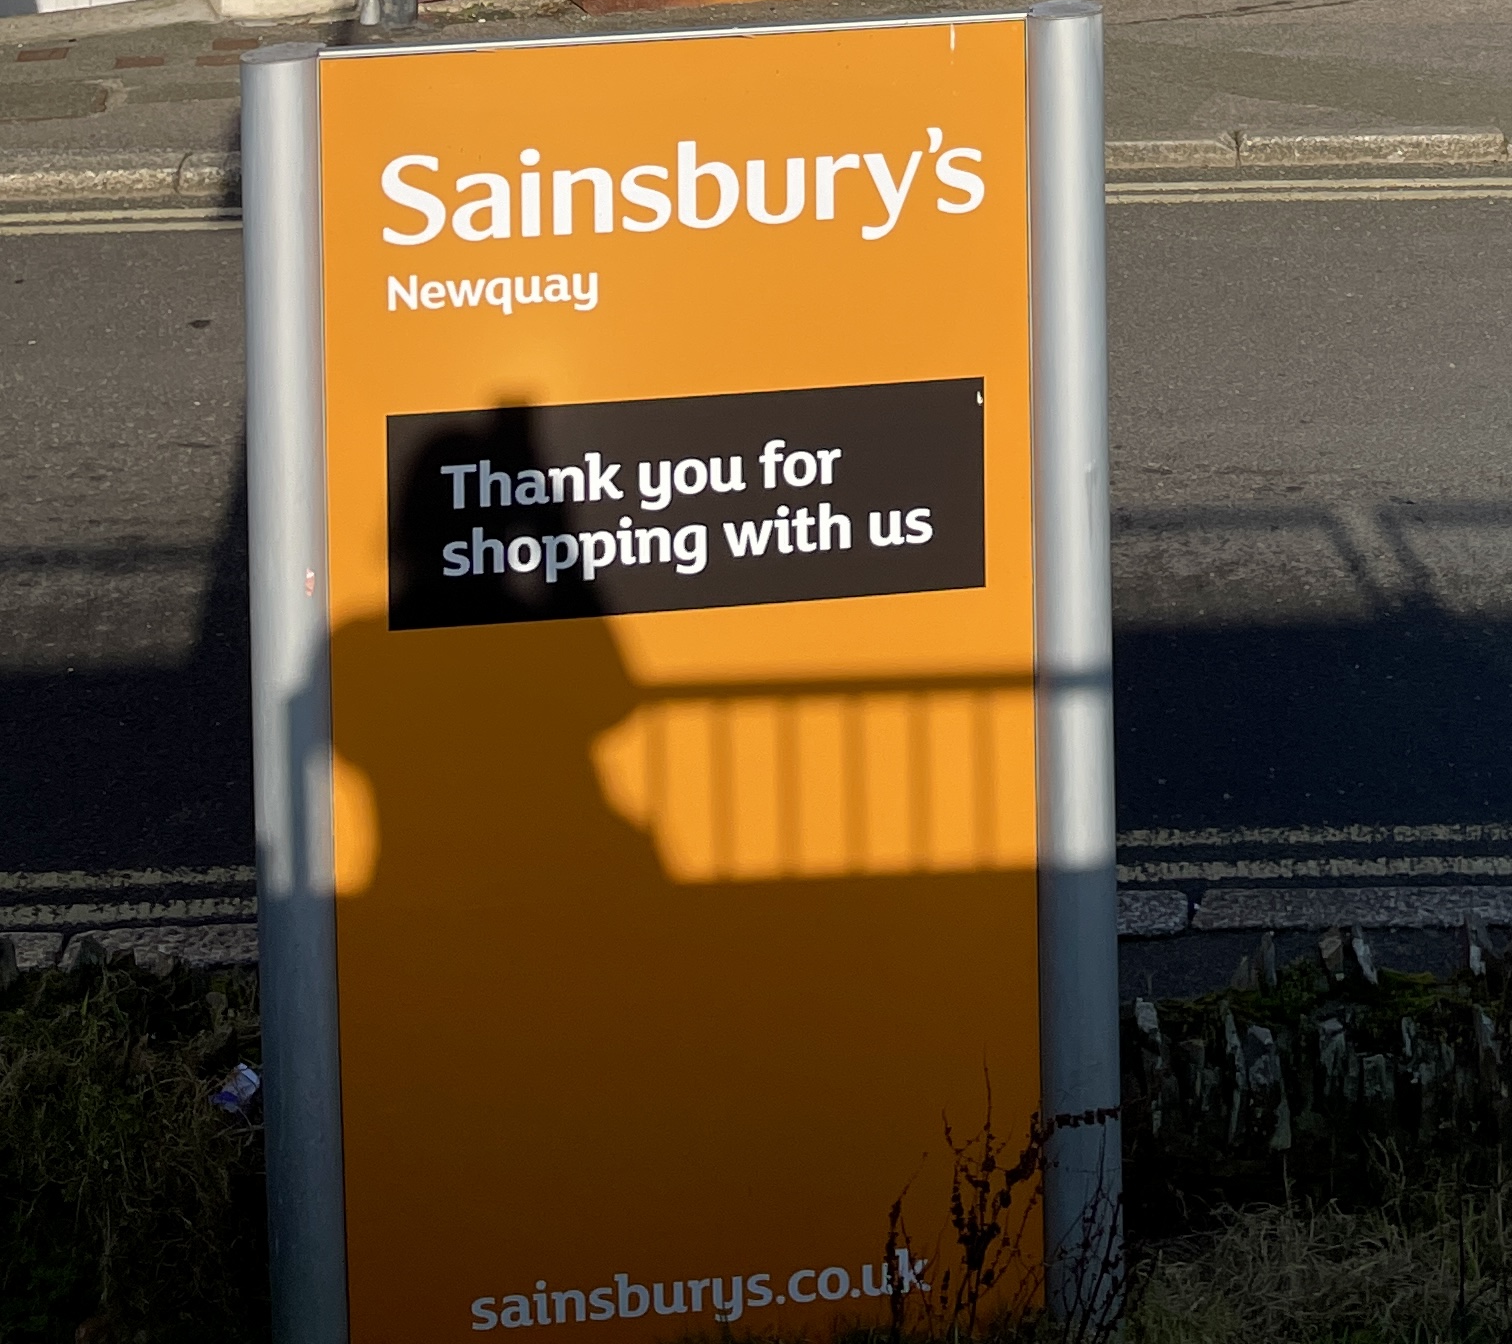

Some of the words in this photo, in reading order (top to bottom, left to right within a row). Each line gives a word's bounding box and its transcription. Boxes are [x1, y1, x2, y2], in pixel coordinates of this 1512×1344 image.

[380, 127, 985, 246] Sainsbury's
[387, 272, 598, 315] Newquay
[440, 451, 624, 510] Thank
[638, 456, 747, 511] you
[759, 438, 842, 489] for
[442, 515, 708, 583] shopping
[722, 502, 852, 557] with
[869, 507, 934, 547] us
[471, 1247, 931, 1331] sainsburys.co.uk
